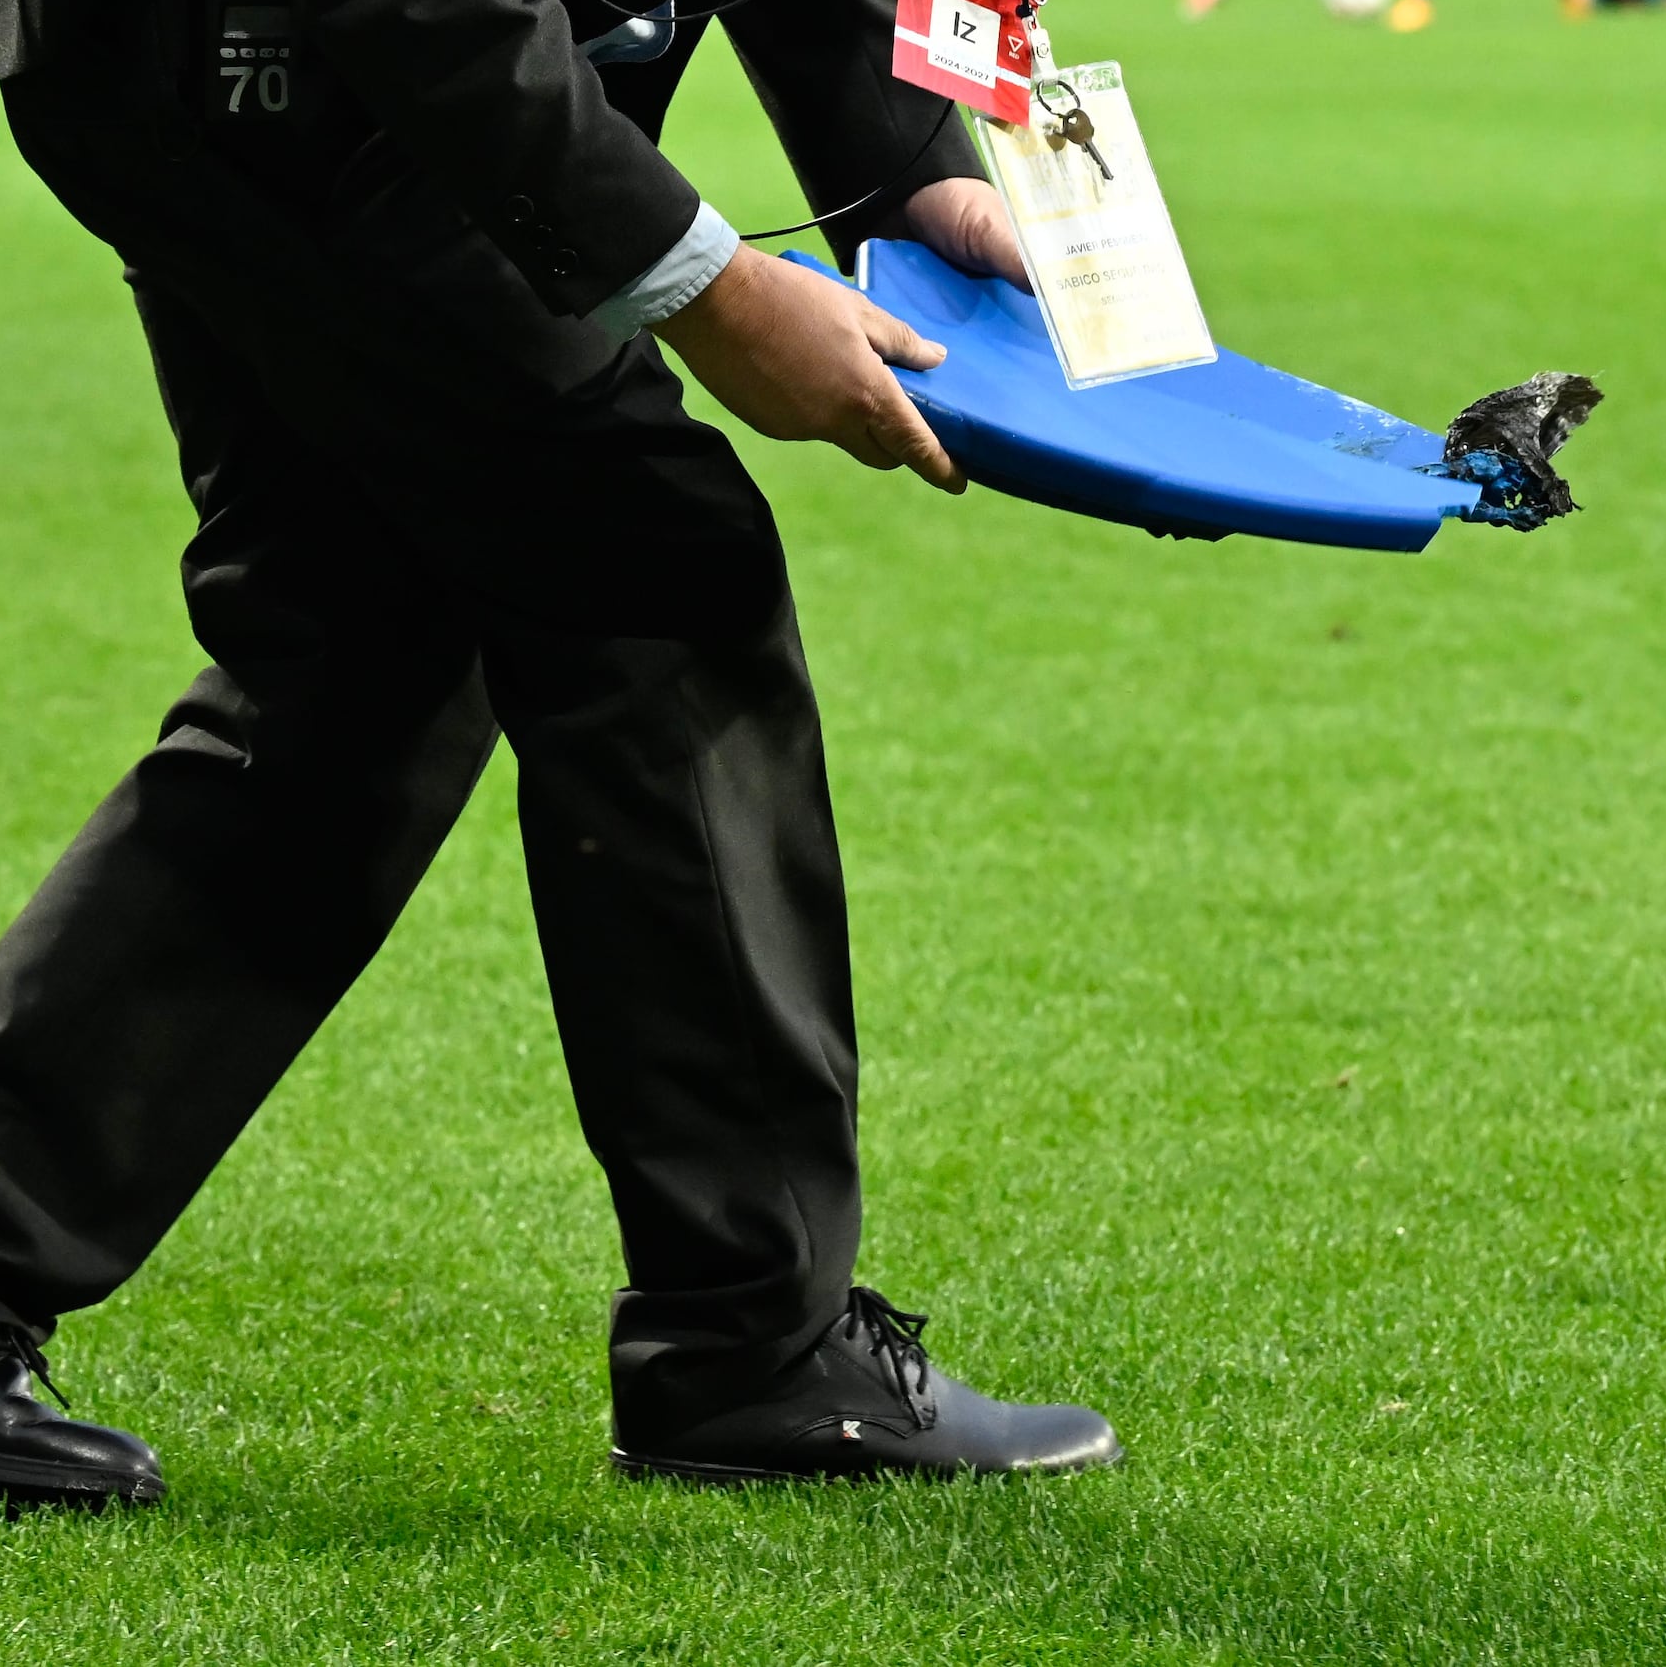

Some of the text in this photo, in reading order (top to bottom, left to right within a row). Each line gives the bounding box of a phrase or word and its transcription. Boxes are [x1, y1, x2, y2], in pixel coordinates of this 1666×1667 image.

[934, 53, 990, 81] 2024-2027
[219, 65, 289, 113] 70
[1065, 240, 1099, 256] JAVIER
[1055, 272, 1101, 291] SABICO
